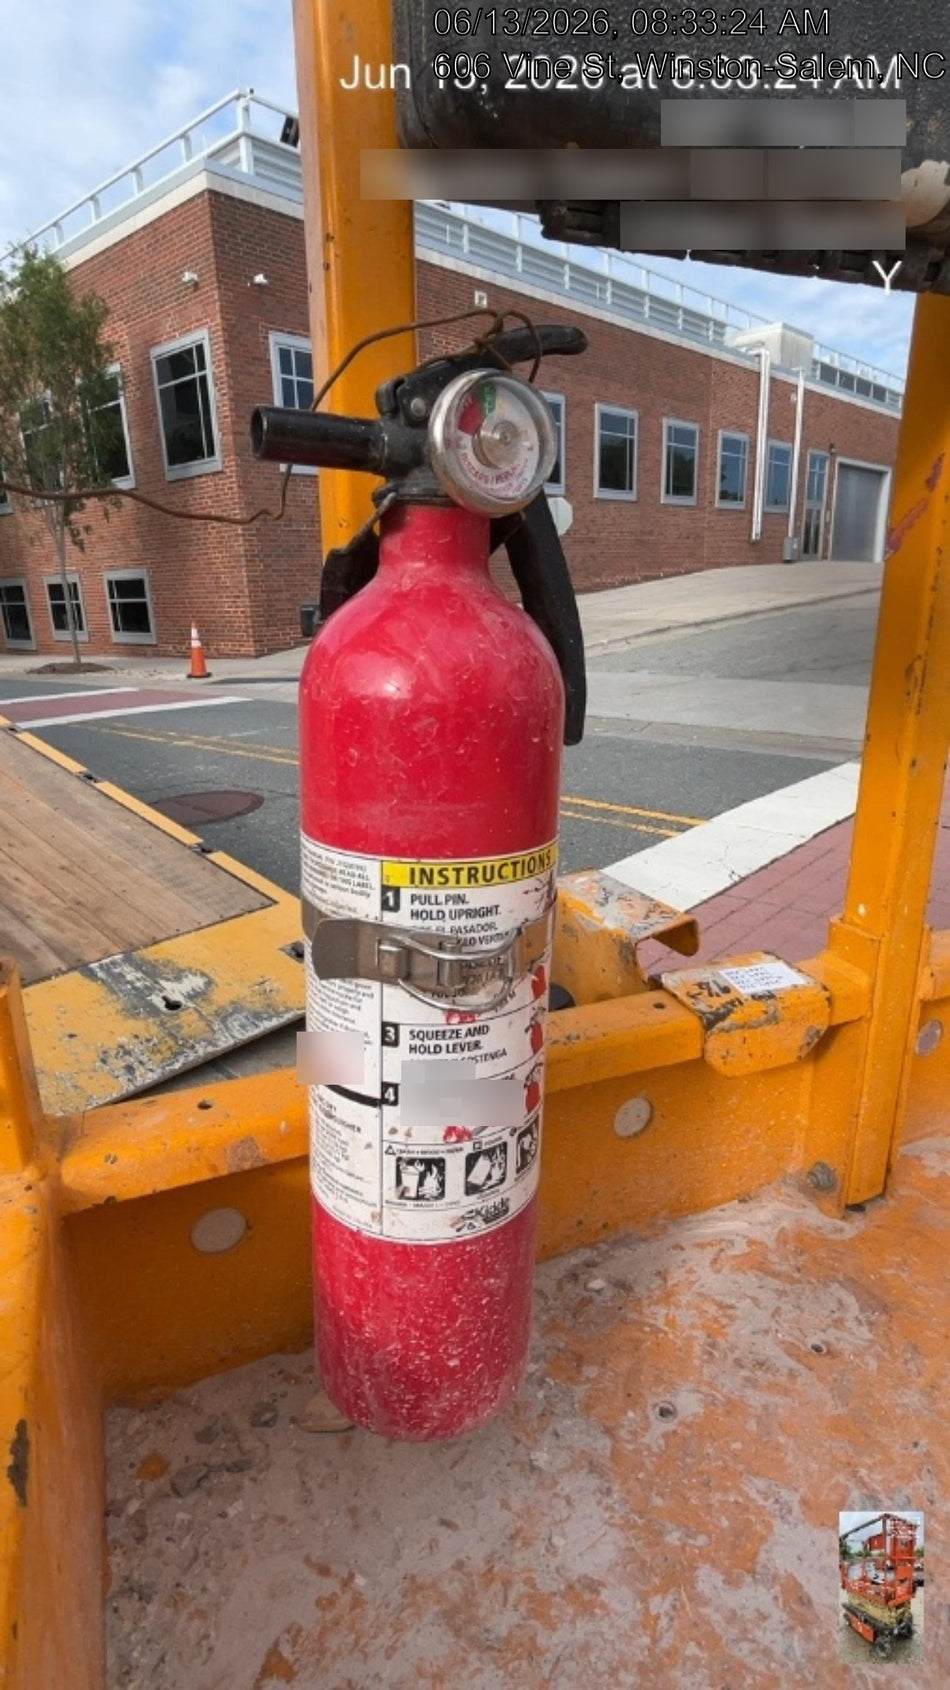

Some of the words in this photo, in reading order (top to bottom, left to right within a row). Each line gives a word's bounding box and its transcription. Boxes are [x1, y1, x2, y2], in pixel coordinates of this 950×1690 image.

[409, 849, 551, 885] INSTRUCTIONS
[385, 890, 396, 907] 1
[410, 893, 442, 906] PULL
[444, 894, 469, 905] PIN.
[410, 908, 445, 922] HOLD
[449, 904, 502, 921] UPRIGHT.
[384, 1026, 395, 1043] 3
[408, 1028, 463, 1042] SQUEEZE
[464, 1024, 490, 1037] AND
[408, 1042, 443, 1055] HOLD
[445, 1040, 483, 1055] LEVER.
[384, 1086, 395, 1102] 4
